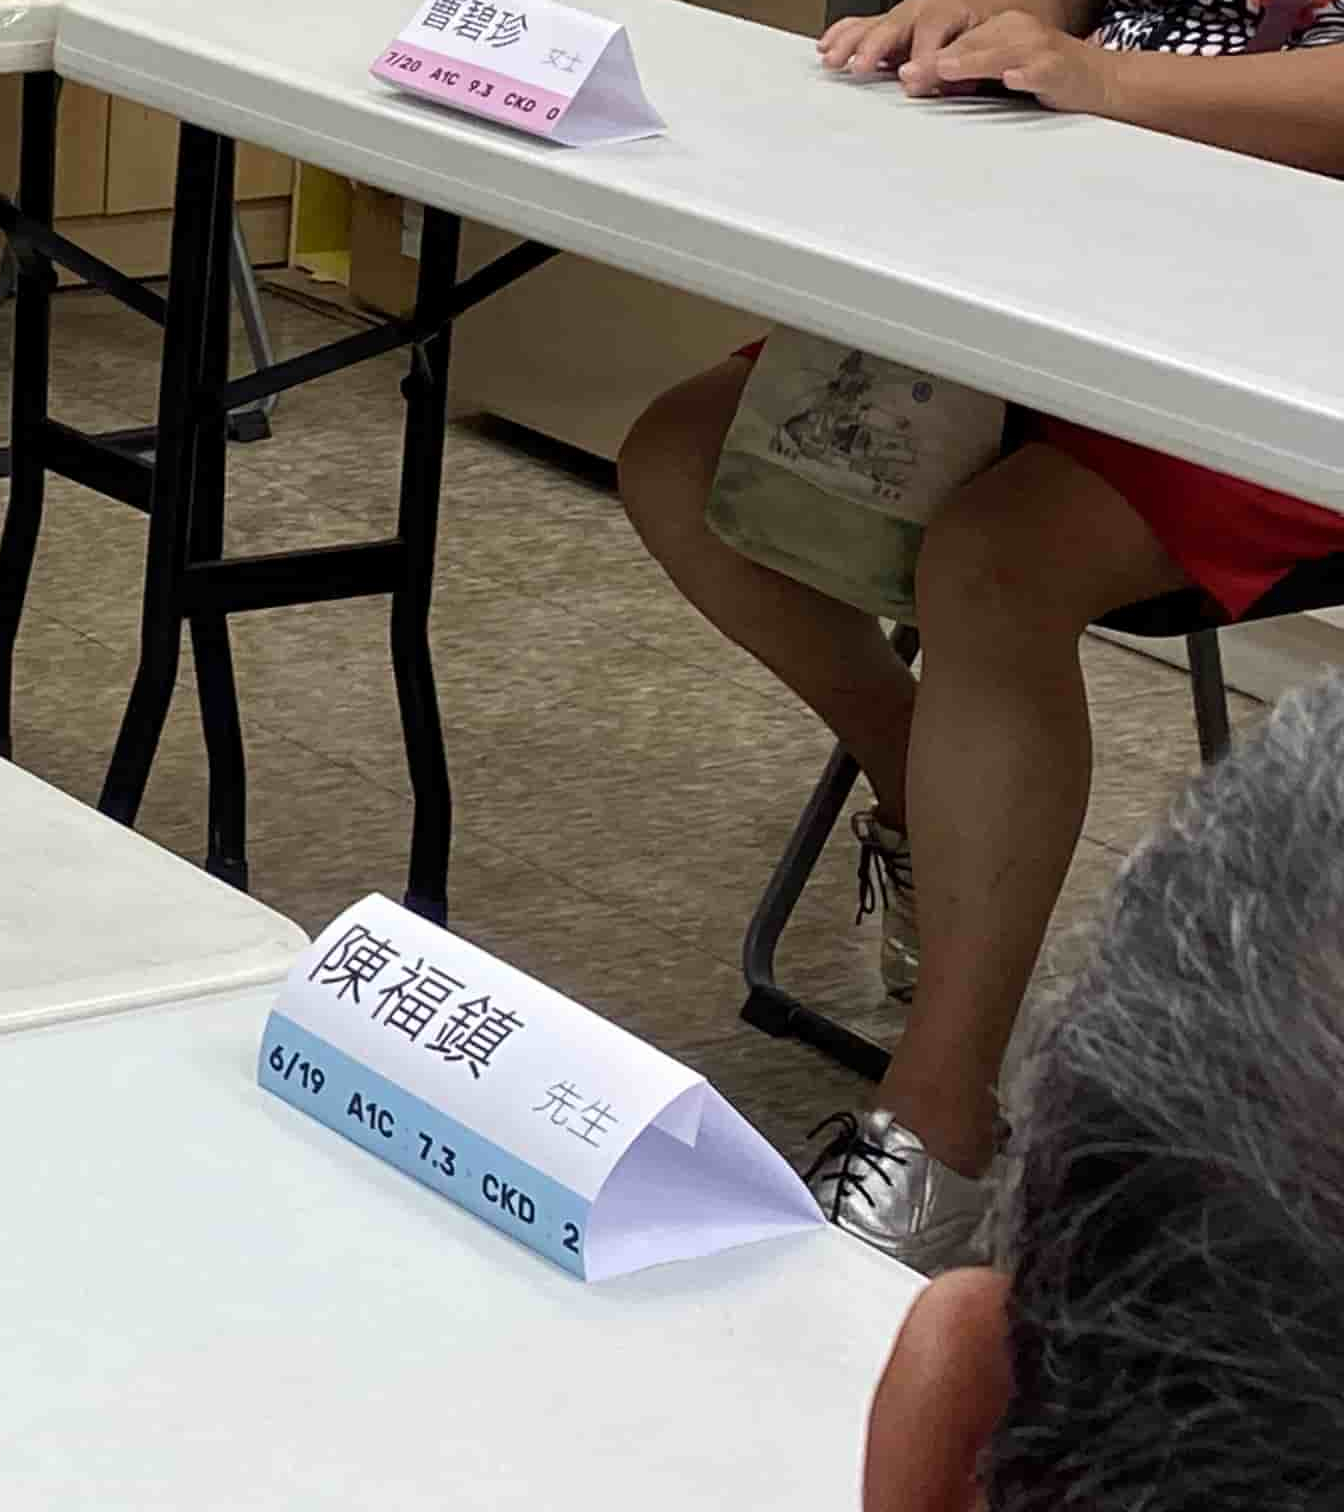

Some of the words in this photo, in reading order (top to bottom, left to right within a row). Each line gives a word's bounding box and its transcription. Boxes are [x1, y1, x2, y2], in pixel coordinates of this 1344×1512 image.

[385, 51, 422, 73] 7/20
[429, 67, 460, 86] A1C
[468, 79, 495, 98] 9.3
[504, 92, 537, 113] CKD
[308, 922, 524, 1080] 陳福鎮
[531, 1079, 620, 1148] 先生
[267, 1044, 326, 1095] 6/19
[347, 1091, 395, 1139] A1C
[418, 1131, 458, 1177] 7.3
[481, 1173, 536, 1226] CKD
[562, 1223, 581, 1253] 2
